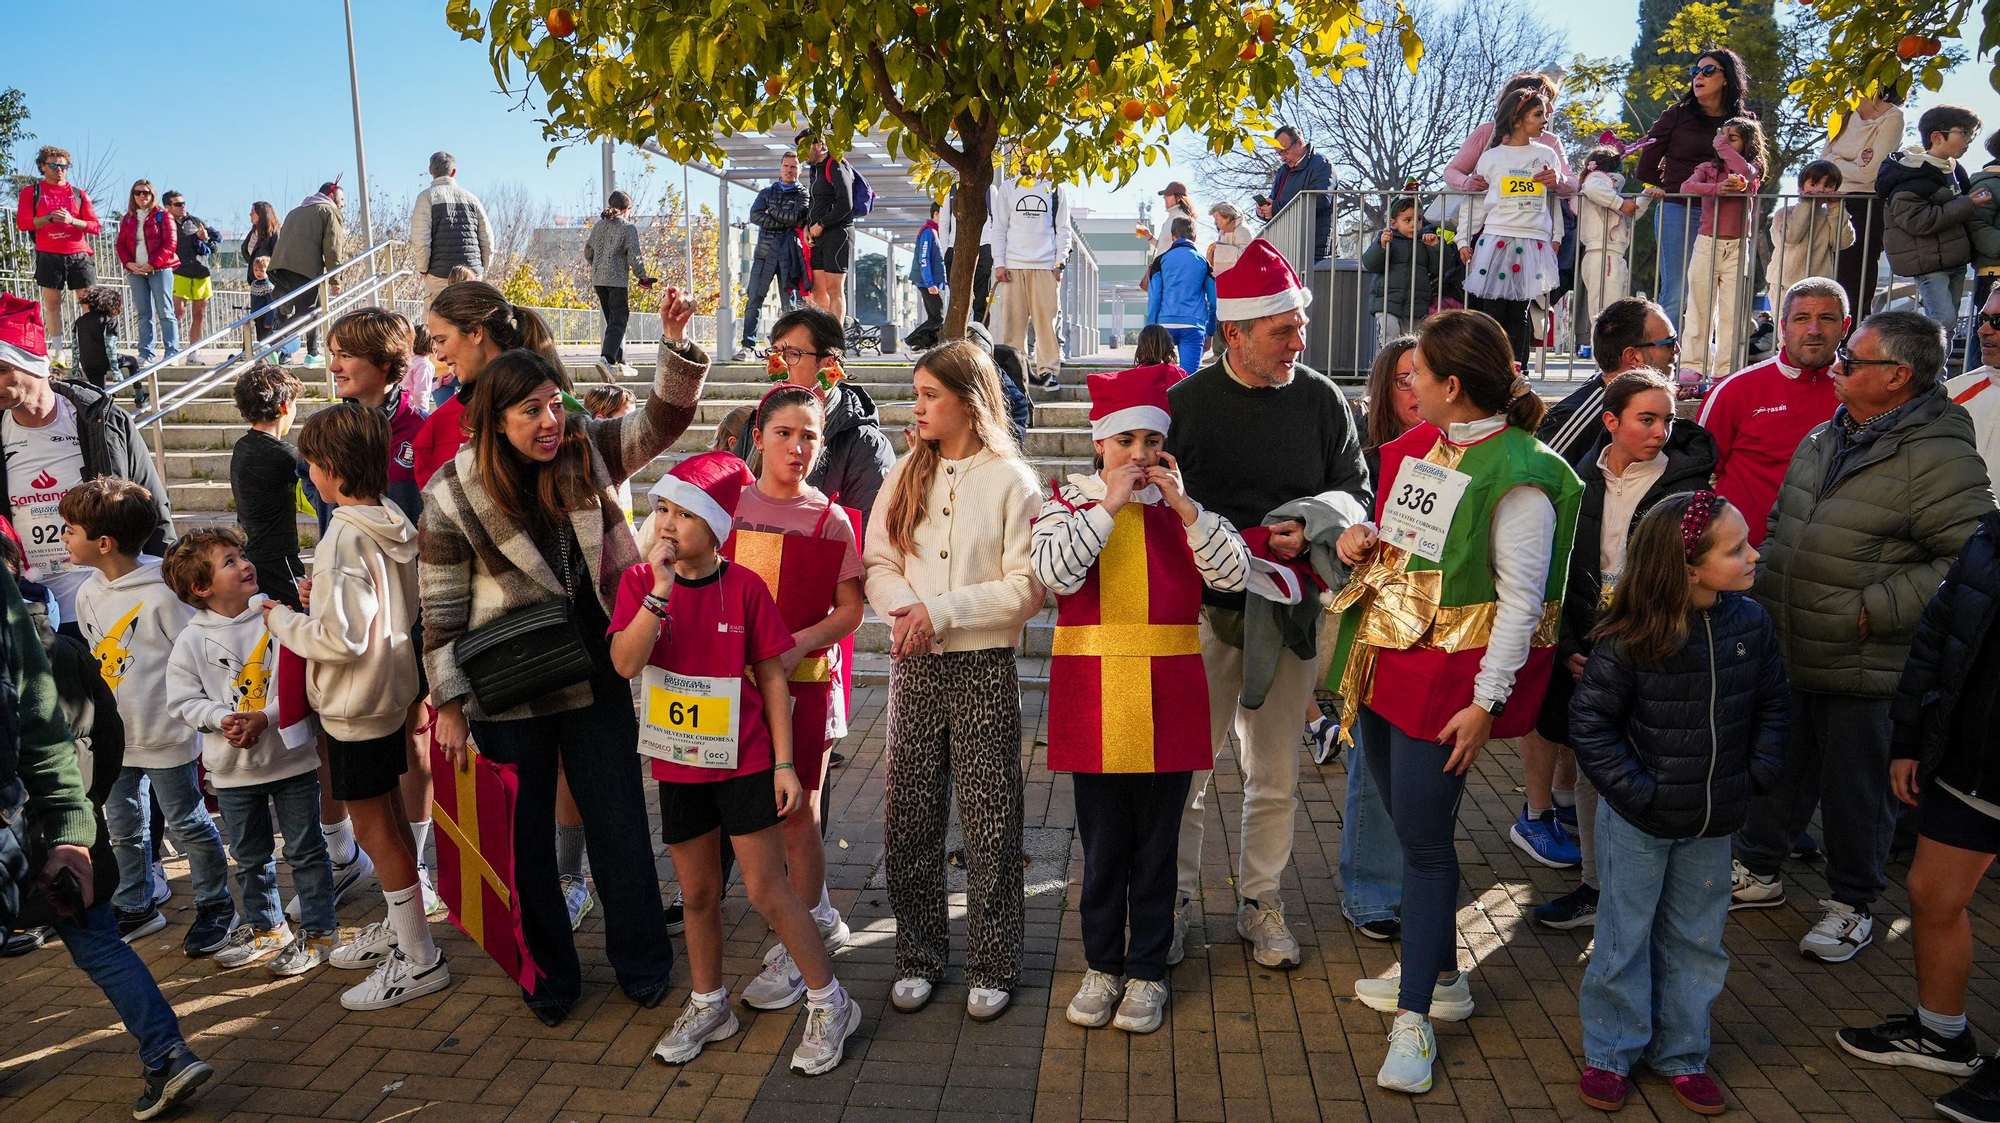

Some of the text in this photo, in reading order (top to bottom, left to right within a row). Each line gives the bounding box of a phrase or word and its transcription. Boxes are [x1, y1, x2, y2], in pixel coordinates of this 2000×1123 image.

[1510, 180, 1534, 192] 258
[1397, 484, 1437, 515] 336
[1423, 540, 1435, 549] GCC
[670, 701, 698, 728] 61
[664, 728, 694, 739] SILVESTRE
